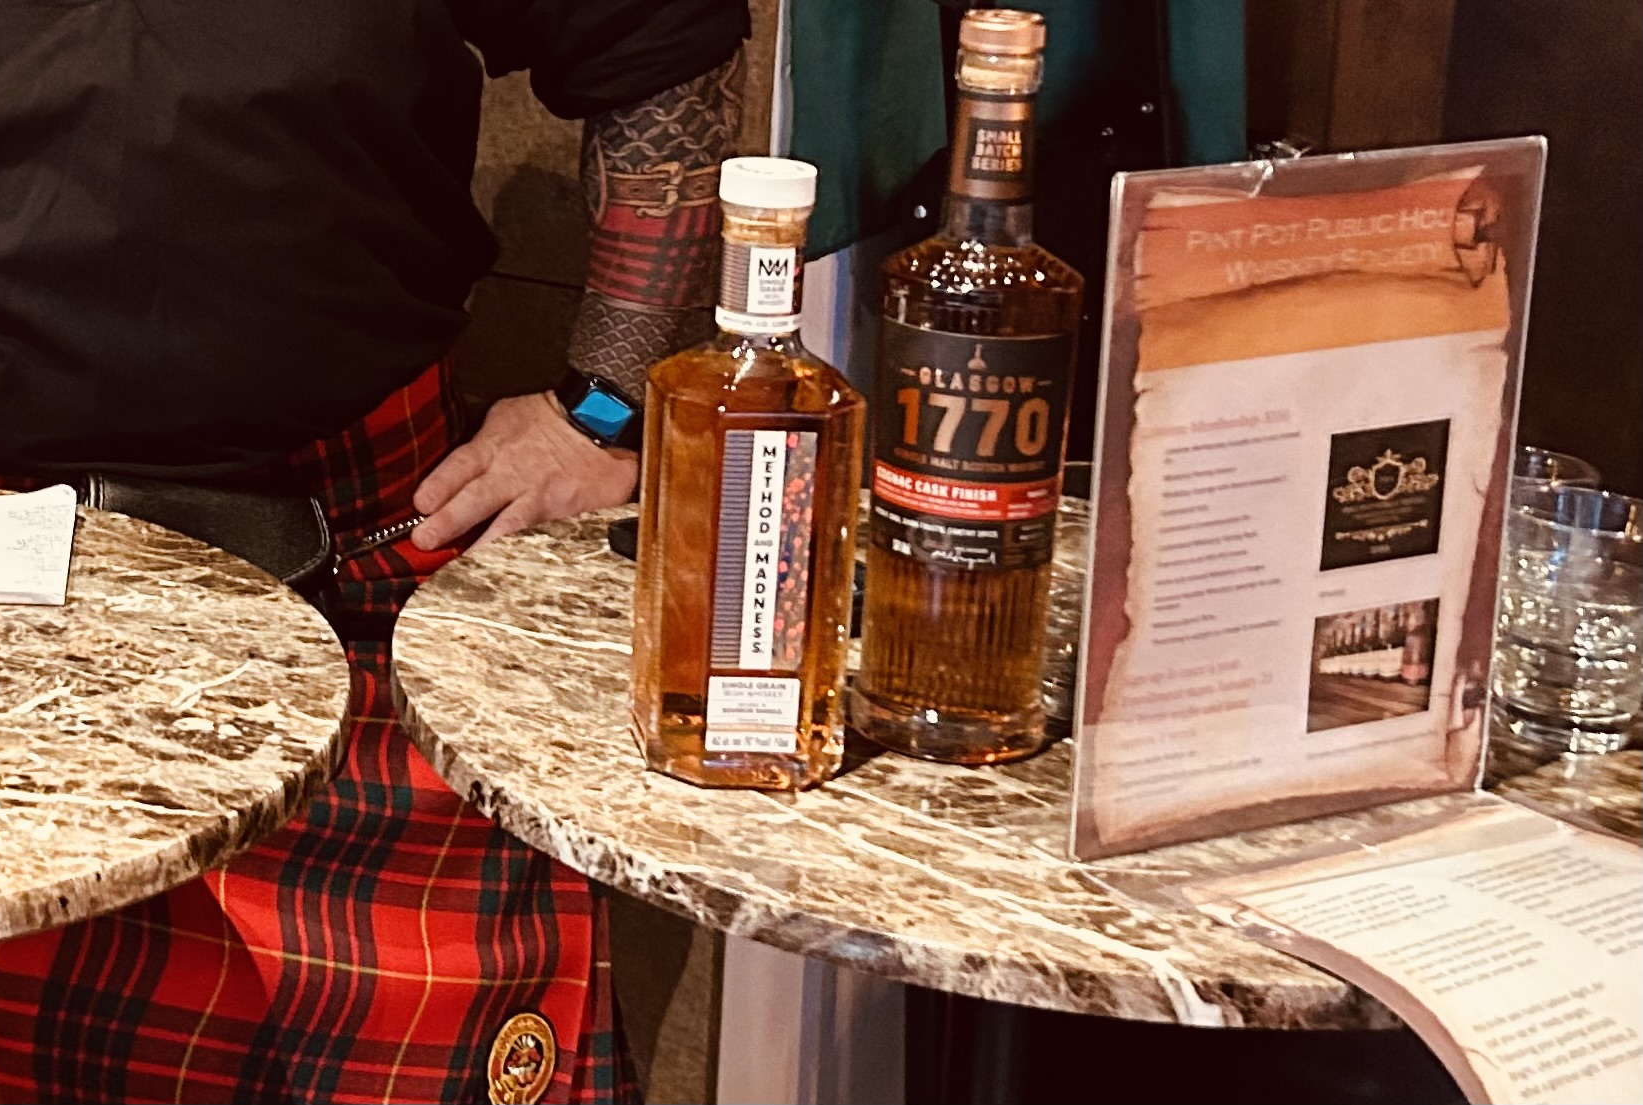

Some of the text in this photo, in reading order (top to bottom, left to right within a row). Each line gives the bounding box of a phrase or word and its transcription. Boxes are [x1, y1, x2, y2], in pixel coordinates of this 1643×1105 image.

[1307, 212, 1395, 240] PUBLIC
[919, 366, 1035, 393] GLASGOW
[897, 387, 1050, 456] 1770
[759, 445, 778, 534] METHOD
[915, 480, 948, 498] CASK
[951, 486, 998, 502] FINISH
[752, 552, 770, 654] MADNESS
[756, 681, 787, 690] GRAIN
